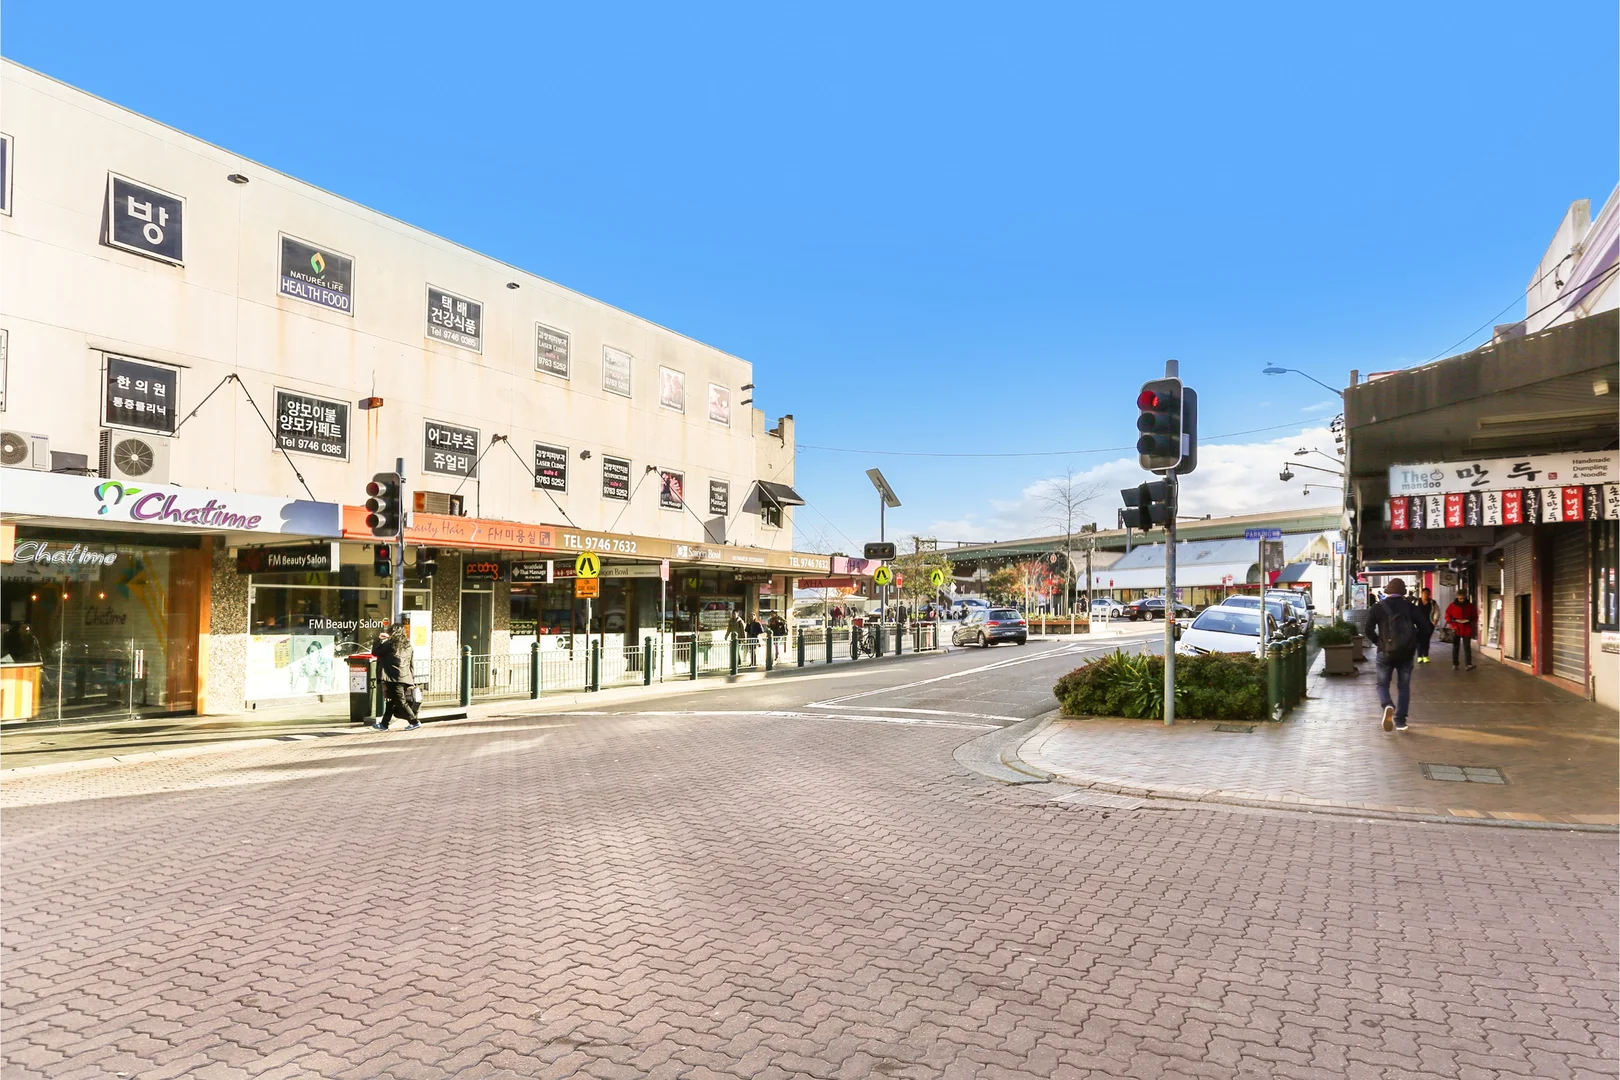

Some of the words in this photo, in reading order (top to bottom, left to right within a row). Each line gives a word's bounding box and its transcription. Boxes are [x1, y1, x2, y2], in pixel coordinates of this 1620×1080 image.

[127, 196, 169, 246] 방
[282, 278, 320, 301] HEALTH
[322, 291, 349, 309] FOOD
[327, 281, 344, 293] LIFE
[431, 307, 477, 335] 건강식품
[430, 326, 442, 337] Tel
[443, 329, 460, 342] 9746
[460, 336, 477, 347] 0385
[287, 401, 337, 424] 양모이불
[280, 415, 342, 438] 양모카페트
[281, 436, 296, 447] Tel
[298, 439, 319, 451] 9746
[321, 443, 342, 455] 0385
[428, 428, 475, 450] 어그부츠
[433, 452, 468, 473] 쥬얼리
[1572, 457, 1611, 465] Handmade
[1401, 470, 1429, 483] The
[1401, 481, 1441, 490] mandoo
[130, 492, 262, 530] Chatime
[1431, 497, 1441, 528] 손만두
[1488, 493, 1498, 525] 손만두
[1547, 489, 1558, 521] 손만두
[442, 520, 464, 536] Hair
[1245, 530, 1272, 538] PARKING
[13, 540, 118, 566] Chatime
[564, 534, 583, 549] TEL
[585, 537, 611, 551] 9746
[613, 541, 637, 553] 7632
[268, 554, 281, 566] FM
[282, 555, 306, 565] Beauty
[307, 553, 327, 564] Salon
[707, 549, 721, 559] Bowl
[789, 557, 800, 566] TEL
[801, 559, 815, 569] 9746
[614, 568, 629, 576] Bowl
[308, 618, 324, 629] FM
[326, 619, 358, 632] Beauty
[359, 618, 383, 629] Salon
